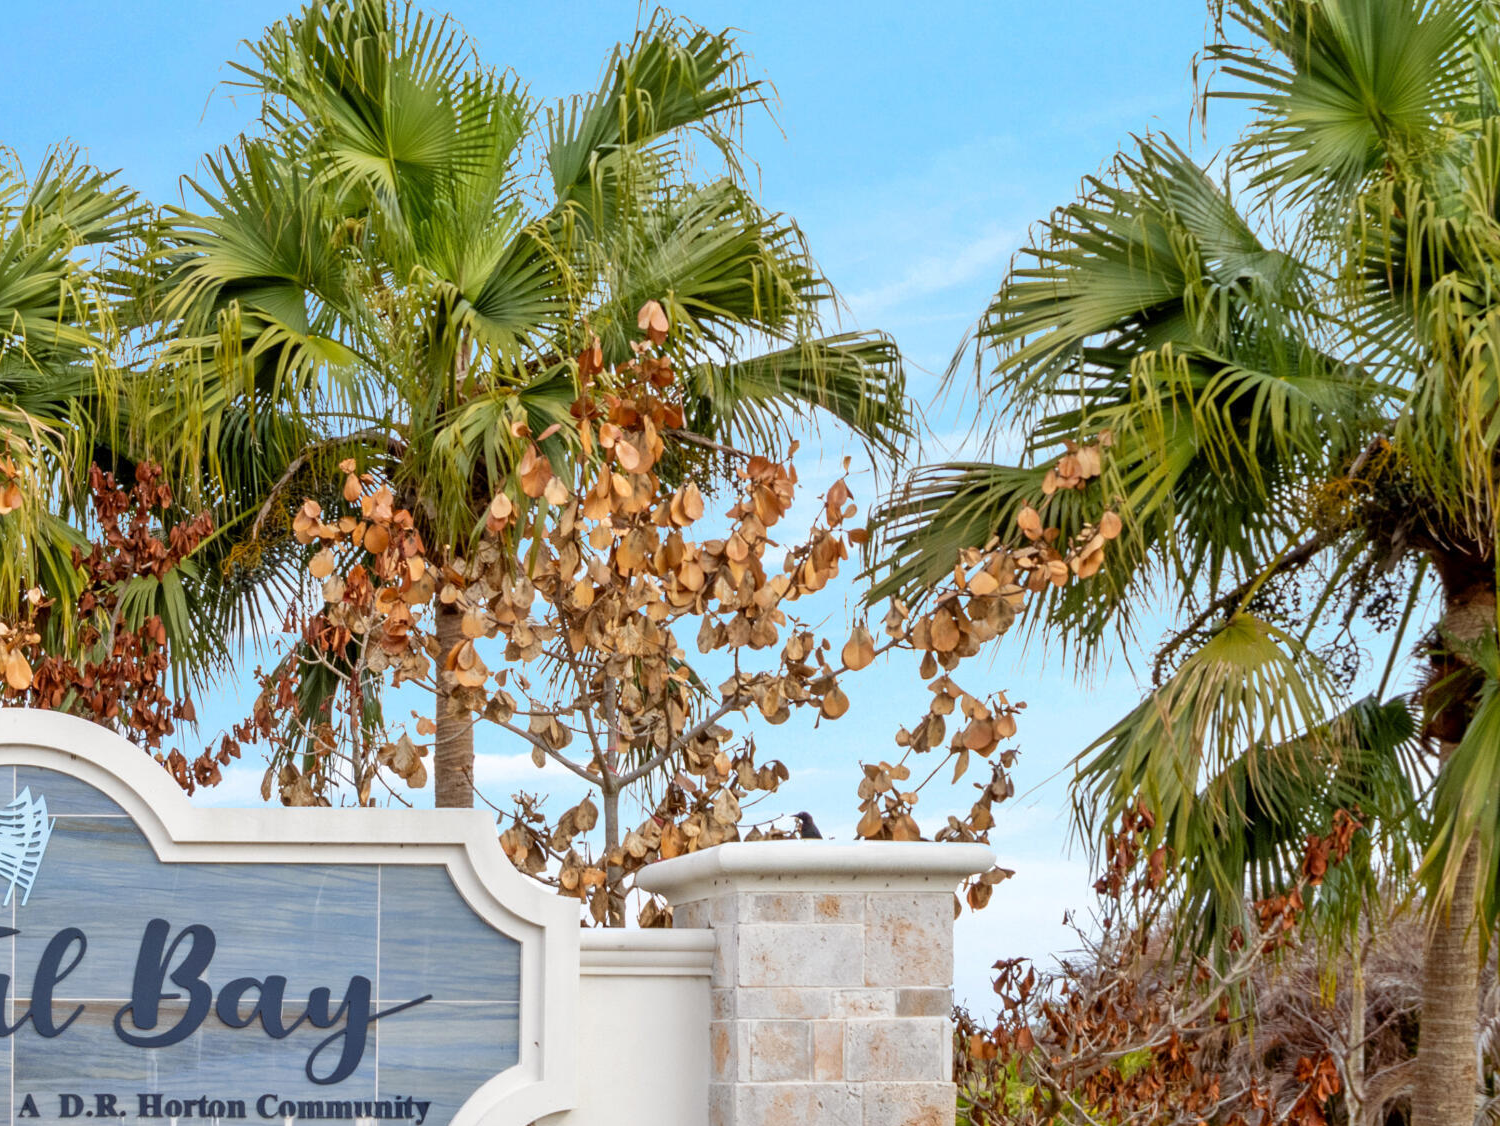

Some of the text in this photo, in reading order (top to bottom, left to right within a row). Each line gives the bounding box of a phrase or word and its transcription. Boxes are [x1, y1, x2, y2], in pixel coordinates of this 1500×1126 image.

[113, 918, 433, 1086] Bay
[18, 1093, 432, 1126] A D.R. Horton Community
